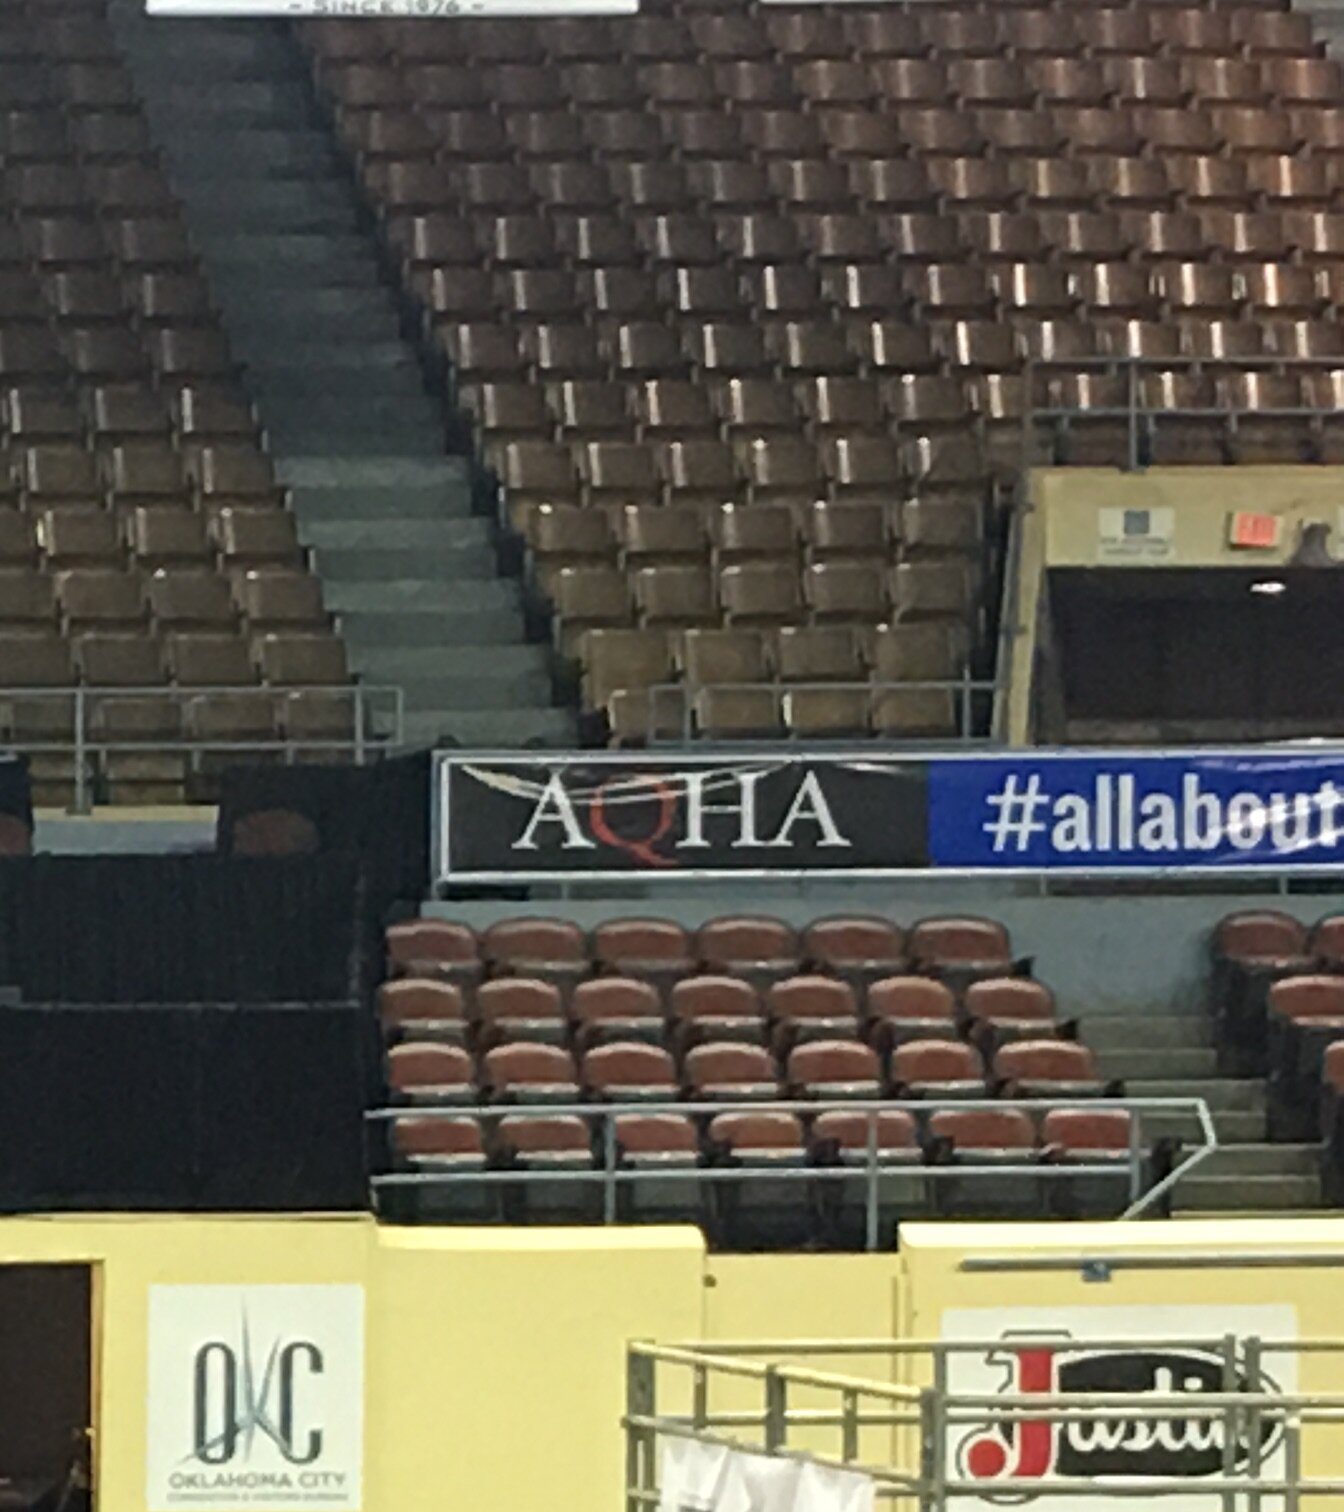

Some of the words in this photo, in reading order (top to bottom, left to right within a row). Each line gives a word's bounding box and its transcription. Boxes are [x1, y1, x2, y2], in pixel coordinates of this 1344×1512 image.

[511, 769, 853, 866] AQHA
[983, 773, 1344, 852] #allabout
[168, 1471, 293, 1489] OKLAHOMA
[298, 1471, 346, 1489] CITY
